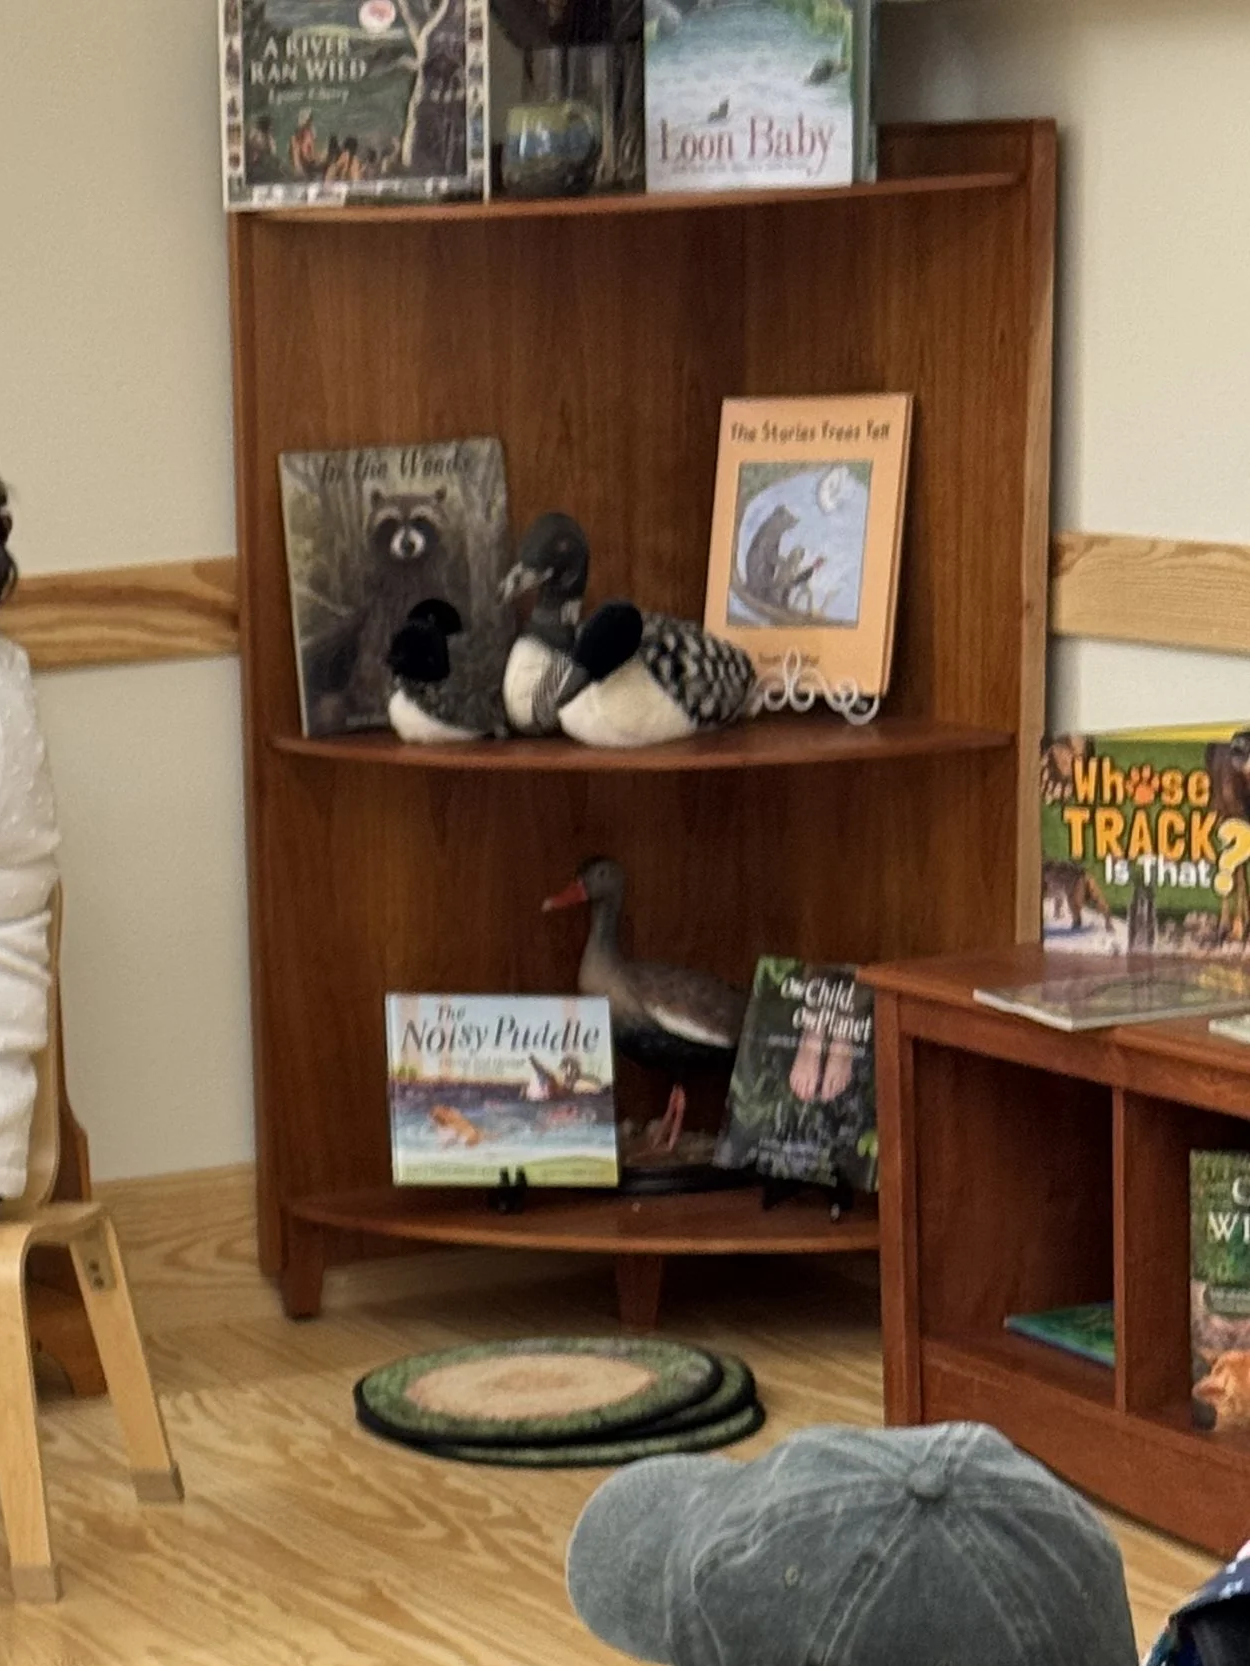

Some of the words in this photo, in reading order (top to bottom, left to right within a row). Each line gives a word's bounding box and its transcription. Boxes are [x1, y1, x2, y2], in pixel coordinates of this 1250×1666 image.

[262, 36, 279, 60] A
[285, 35, 350, 60] RIVER
[249, 60, 299, 86] RAN
[305, 59, 368, 83] WILD
[659, 117, 735, 164] Loon
[748, 112, 836, 178] Baby
[730, 420, 758, 443] The
[761, 419, 817, 445] Stories
[820, 419, 861, 442] Trees
[866, 418, 891, 440] Tell
[1062, 806, 1219, 864] TRACK
[1105, 853, 1130, 886] Is
[436, 1003, 467, 1024] The
[817, 1004, 872, 1043] Planet
[401, 1018, 490, 1057] Noisy
[494, 1014, 600, 1054] Puddle
